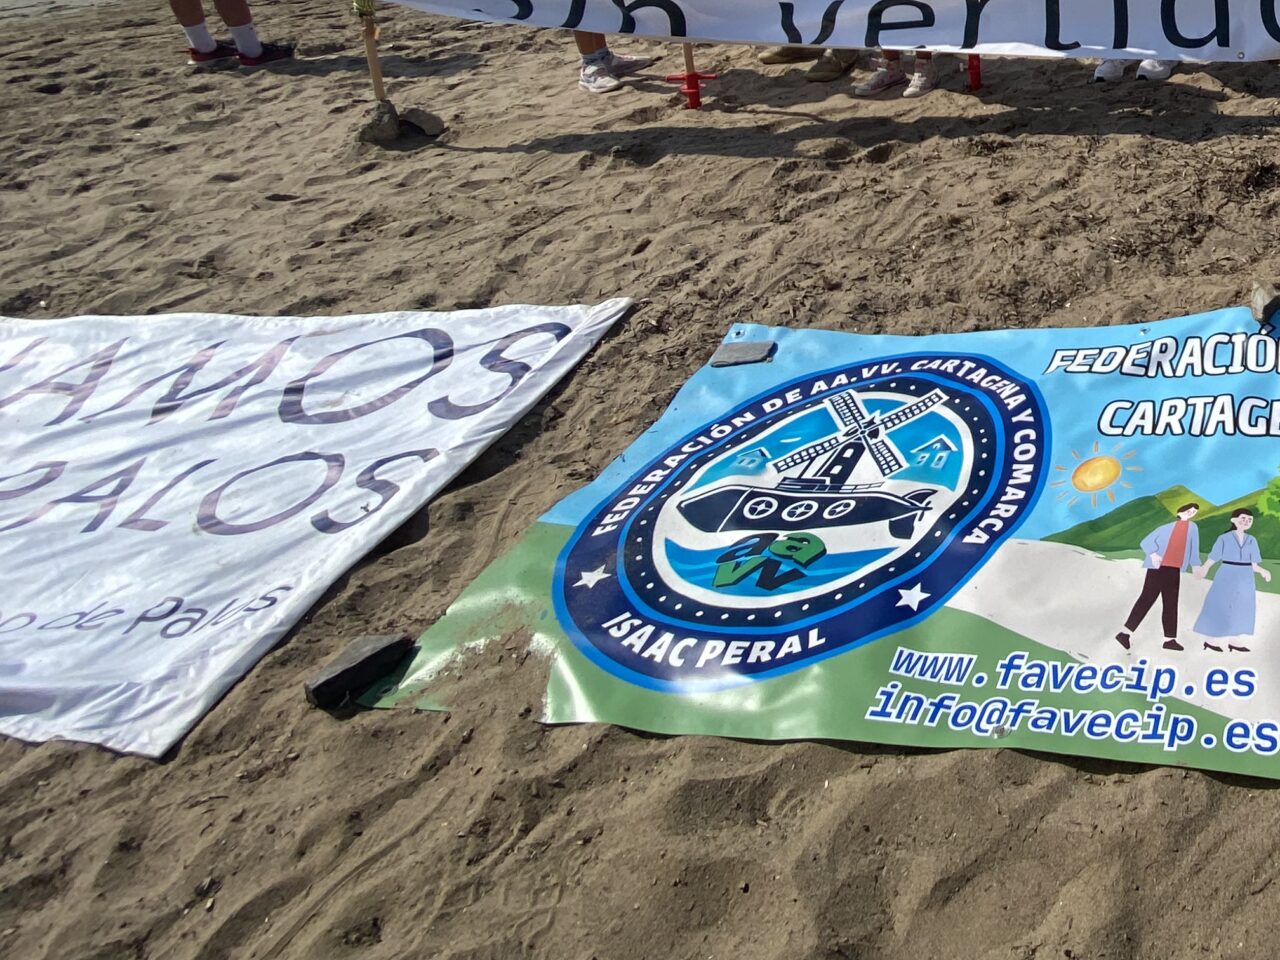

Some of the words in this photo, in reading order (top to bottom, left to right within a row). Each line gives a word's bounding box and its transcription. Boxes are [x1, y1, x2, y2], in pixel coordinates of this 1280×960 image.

[0, 322, 573, 427] AMOS
[910, 359, 1027, 410] CARTAGENA
[763, 391, 803, 415] DE
[1011, 408, 1034, 423] Y
[592, 410, 755, 536] FEDERACIÓN
[962, 428, 1037, 544] COMARCA
[37, 589, 128, 632] de
[601, 611, 697, 668] ISAAC
[695, 628, 827, 668] PERAL
[889, 647, 1259, 702] www.favecip.es
[866, 683, 1280, 755] info@favecip.es
